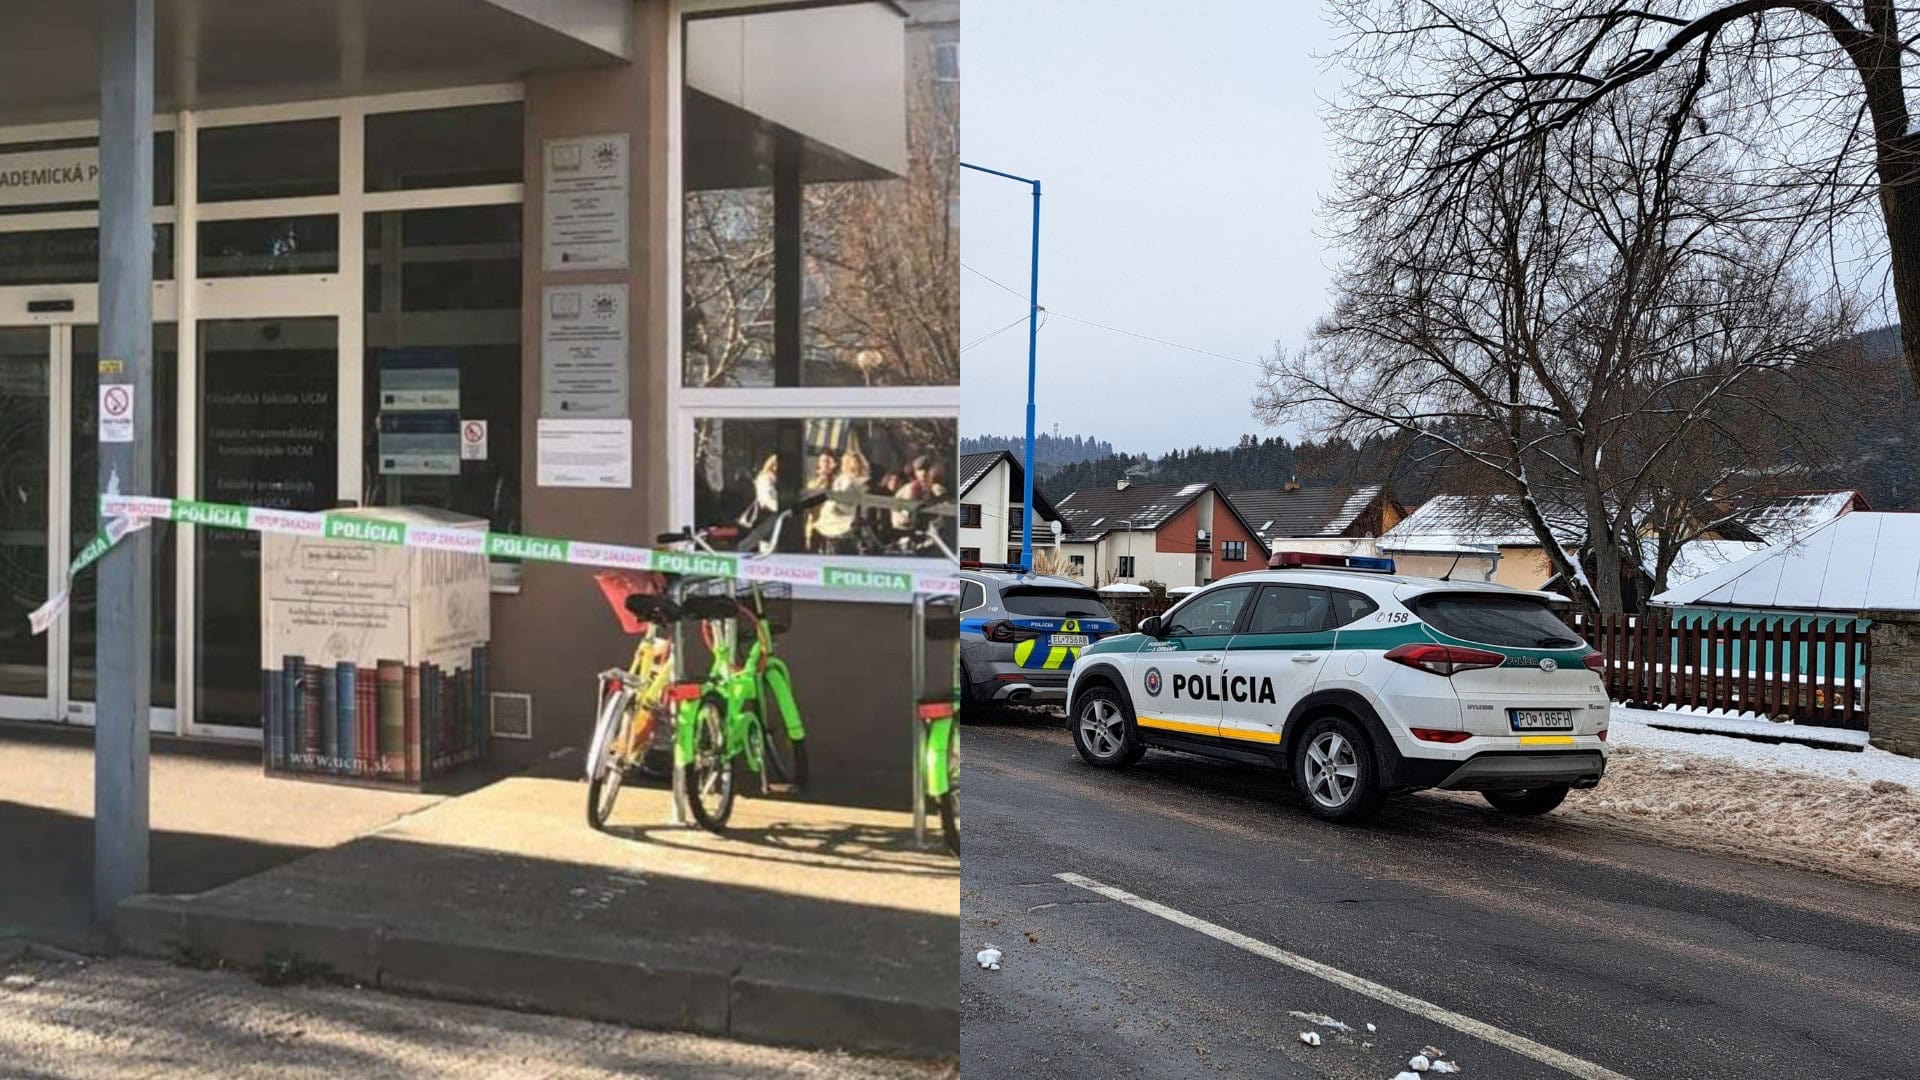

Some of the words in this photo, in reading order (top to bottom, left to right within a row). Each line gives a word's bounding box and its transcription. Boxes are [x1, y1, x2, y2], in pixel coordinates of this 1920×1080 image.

[177, 505, 243, 526] POLÍCIA
[331, 520, 399, 542] POLÍCIA
[492, 537, 563, 560] POLÍCIA
[658, 554, 731, 576] POLÍCIA
[1387, 612, 1409, 624] 158
[1507, 655, 1539, 666] POLÍCIA
[1172, 669, 1277, 704] POLÍCIA
[289, 750, 392, 774] www.ucm.sk
